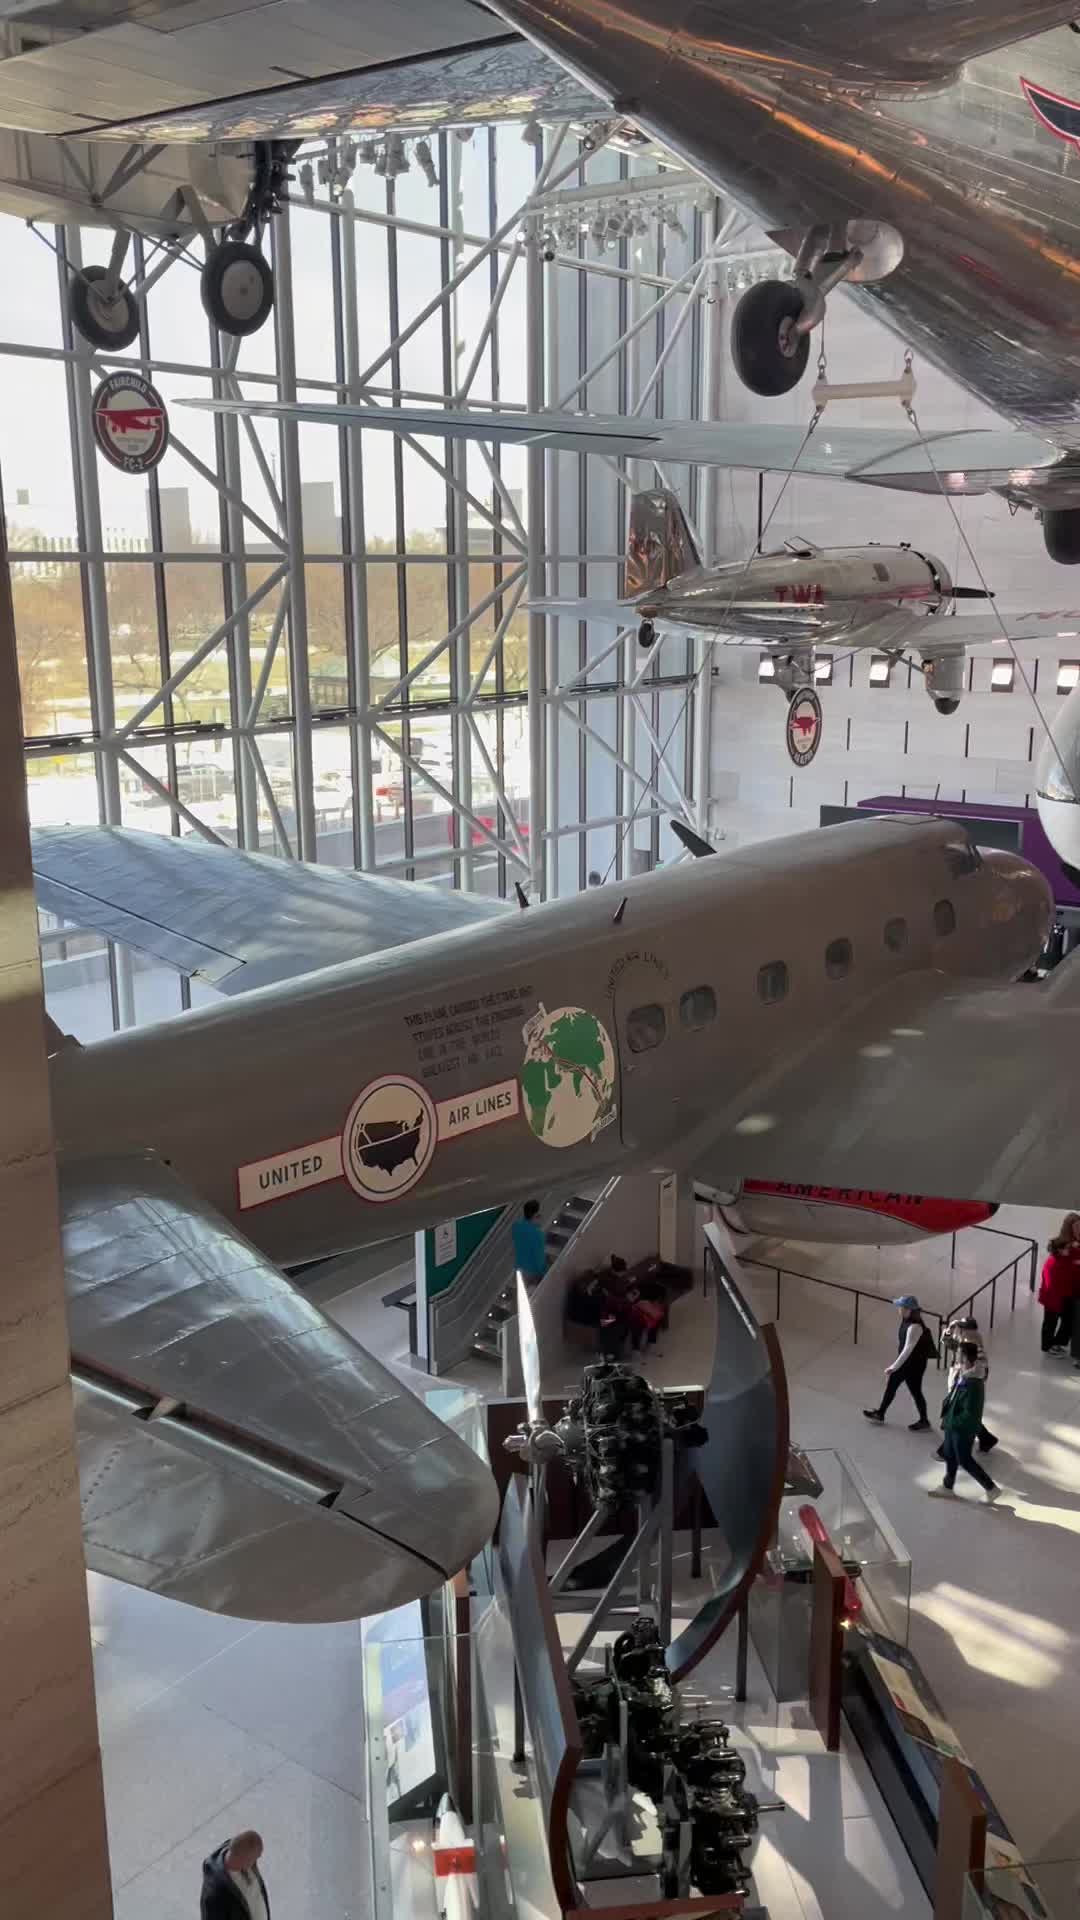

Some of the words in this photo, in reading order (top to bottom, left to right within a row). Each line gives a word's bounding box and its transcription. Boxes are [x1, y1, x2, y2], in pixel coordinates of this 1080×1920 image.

[774, 584, 825, 604] TWA
[448, 1106, 471, 1125] AIR
[475, 1091, 512, 1116] LINES
[258, 1155, 323, 1190] UNITED
